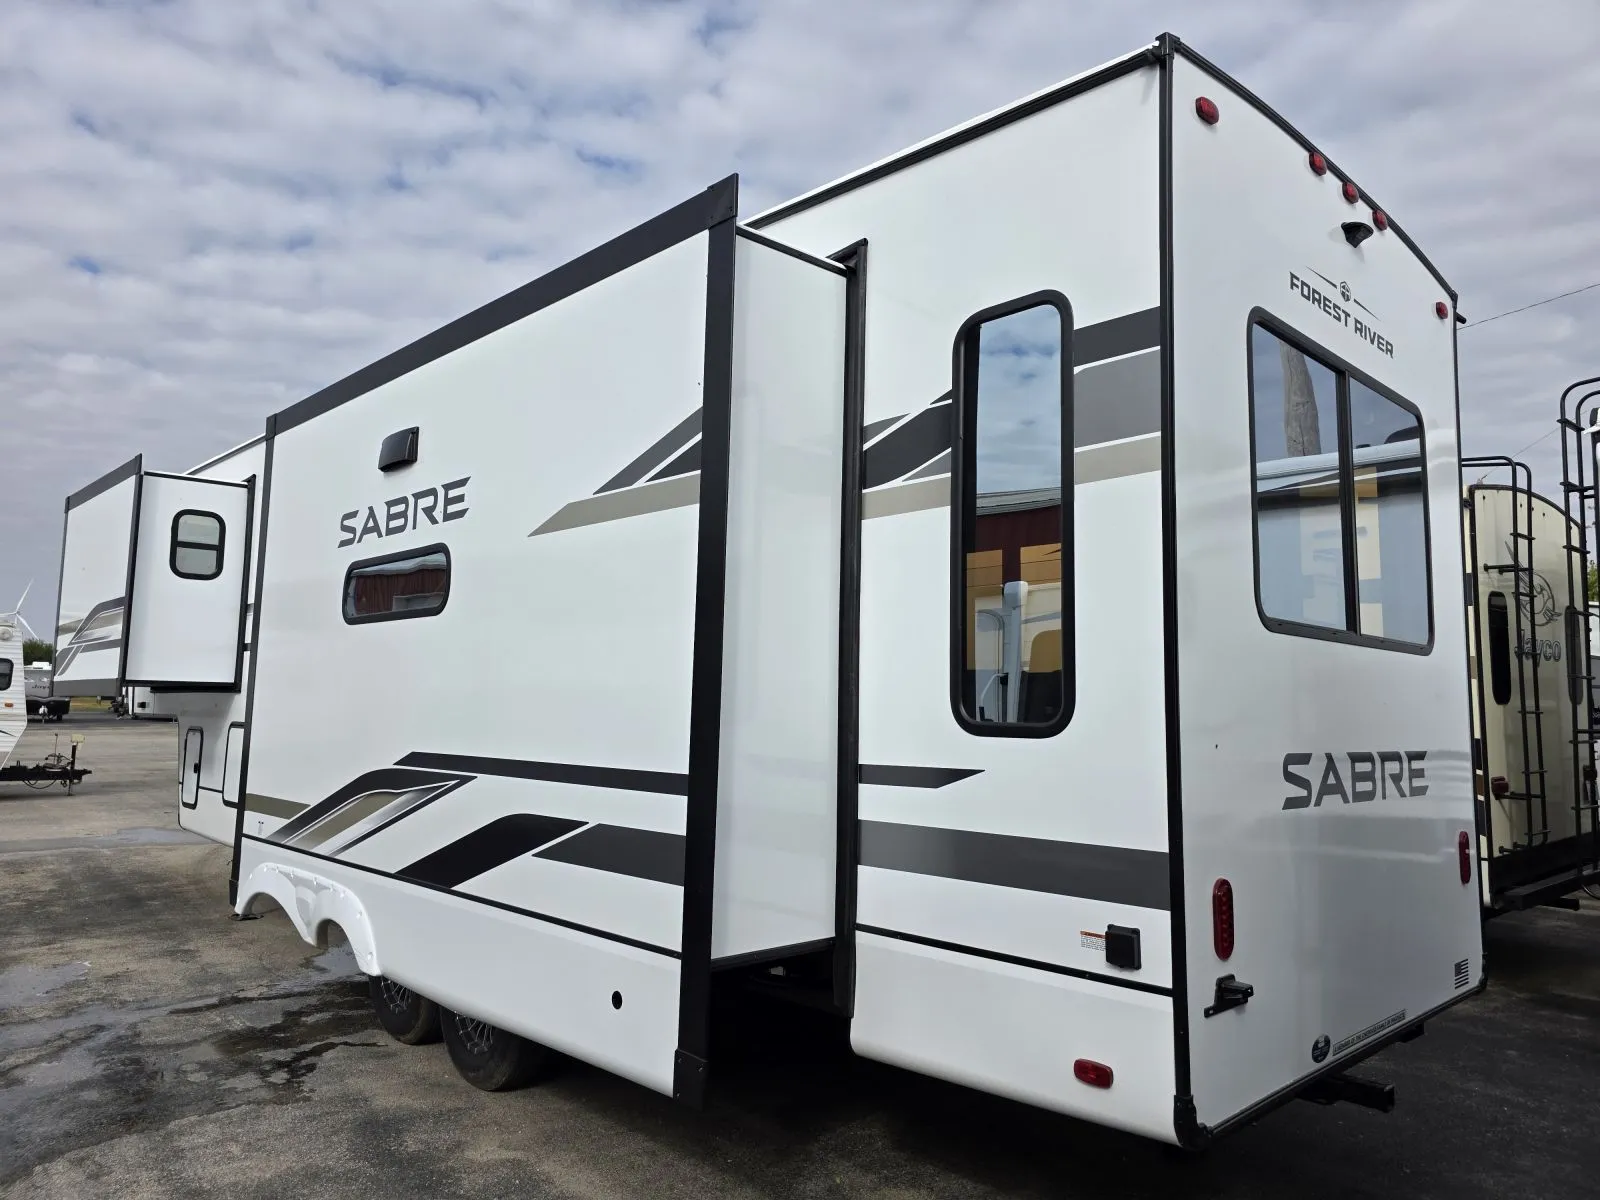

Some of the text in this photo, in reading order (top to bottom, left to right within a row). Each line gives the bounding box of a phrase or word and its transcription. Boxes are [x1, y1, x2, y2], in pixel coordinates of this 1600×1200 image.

[1289, 271, 1394, 359] FOREST RIVER
[337, 476, 471, 549] SABRE
[1282, 750, 1429, 810] SABRE
